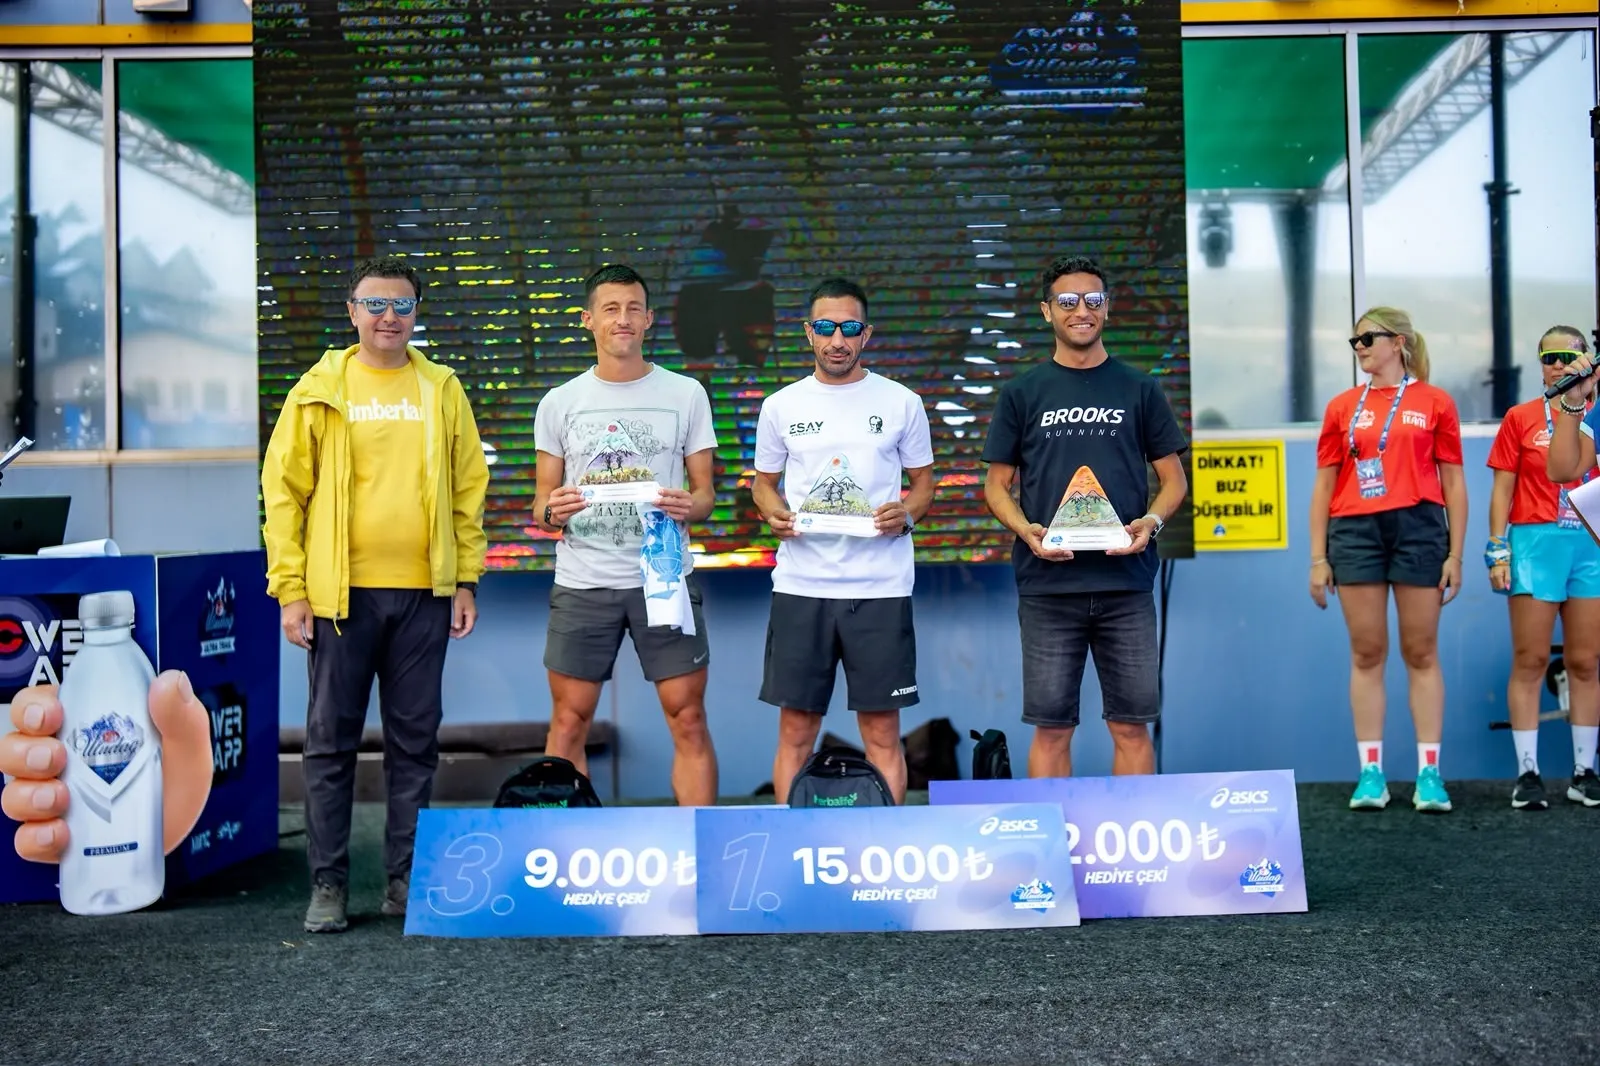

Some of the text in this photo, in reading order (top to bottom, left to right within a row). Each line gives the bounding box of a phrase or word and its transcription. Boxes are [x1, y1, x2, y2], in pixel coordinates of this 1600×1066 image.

[346, 396, 422, 422] imberla
[1040, 406, 1126, 427] BROOKS
[789, 421, 824, 435] ESAY
[1045, 428, 1117, 439] RUNNING
[1197, 452, 1264, 469] DİKKAT!
[1216, 480, 1247, 493] BUZ
[21, 619, 84, 654] WE
[212, 737, 243, 773] APP
[90, 844, 130, 856] PREMIUM
[427, 832, 515, 917] 3.
[722, 832, 781, 912] 1.
[1084, 865, 1168, 886] HEDİYE ÇEKİ
[562, 889, 651, 907] HEDİYE ÇEKİ
[851, 884, 939, 903] HEDİYE ÇEKİ
